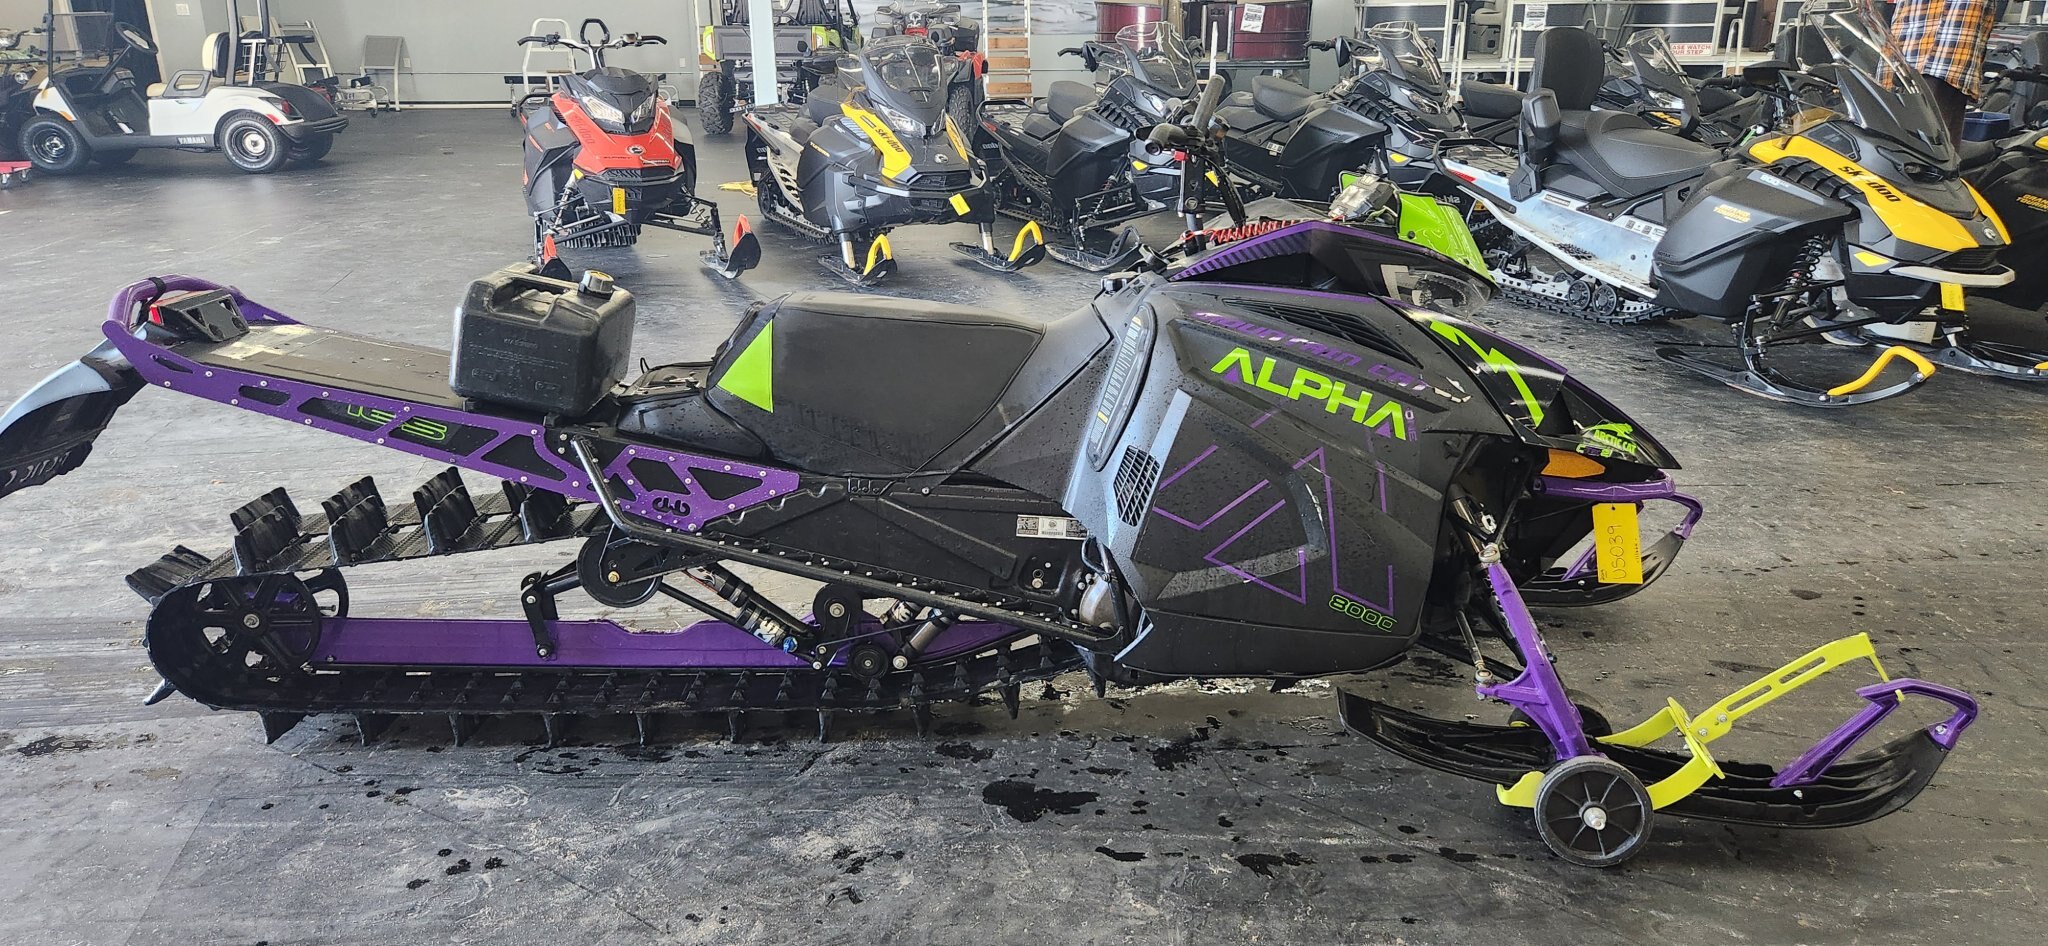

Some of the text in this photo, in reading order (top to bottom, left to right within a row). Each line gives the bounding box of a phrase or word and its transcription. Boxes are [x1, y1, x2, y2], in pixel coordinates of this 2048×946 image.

[177, 136, 206, 145] YAMAHA
[1210, 347, 1406, 441] ALPHA
[1404, 408, 1418, 442] ONE
[1594, 429, 1637, 455] ARCTIC CAT
[1328, 594, 1397, 633] 8000
